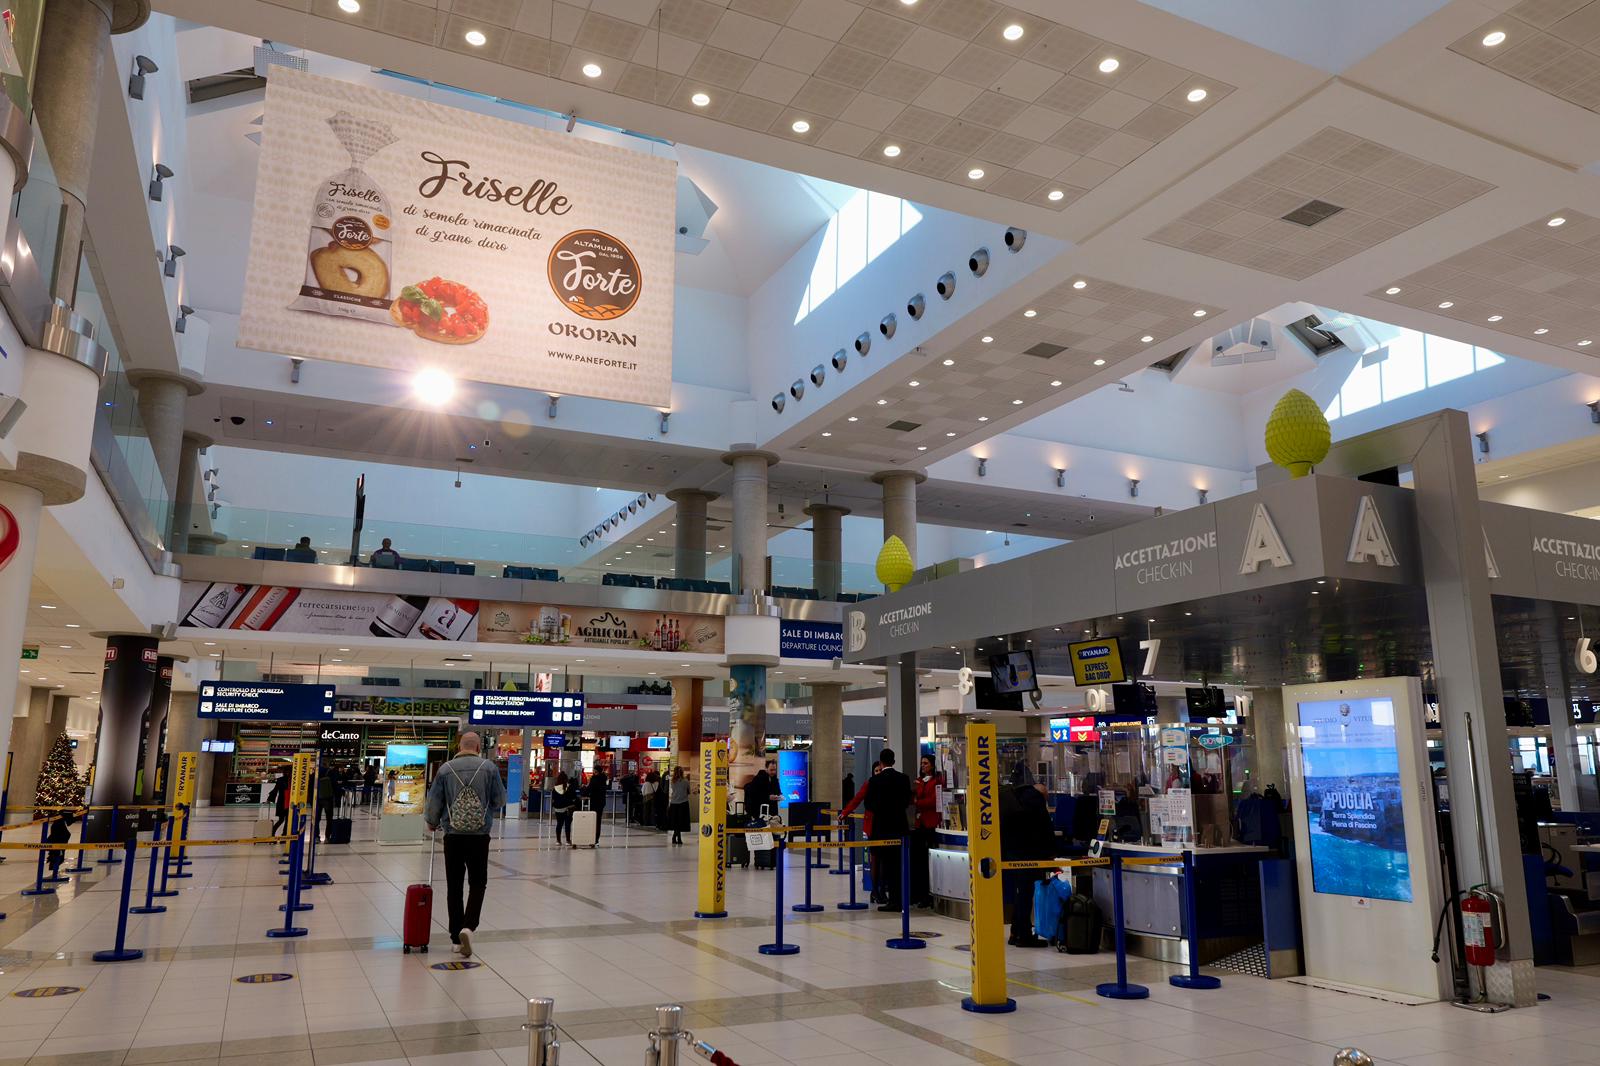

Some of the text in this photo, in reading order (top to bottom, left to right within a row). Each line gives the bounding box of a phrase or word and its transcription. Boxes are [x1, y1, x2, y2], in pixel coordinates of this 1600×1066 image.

[328, 181, 382, 202] Friselle
[418, 151, 572, 216] Friselle
[336, 223, 370, 242] Forte
[403, 204, 542, 240] di semola rimacinata
[416, 225, 508, 251] di grano duro
[574, 240, 618, 253] ALTAMURA
[556, 250, 636, 296] Forte
[548, 322, 637, 348] OROPAN
[548, 350, 638, 370] WWW.PANEFORTE.IT
[1238, 502, 1293, 575] A
[1346, 494, 1400, 567] A
[1114, 531, 1217, 570] ACCETTAZIONE
[1136, 560, 1193, 584] CHECK-IN
[878, 602, 932, 626] ACCETTAZIONE
[575, 626, 638, 640] AGRICOLA
[782, 628, 801, 638] SALE
[804, 630, 812, 638] DI
[848, 610, 867, 652] B
[890, 621, 920, 638] CHECK-IN
[782, 642, 843, 652] DEPARTURE LOUNG
[1082, 648, 1109, 657] RYANAIR
[1139, 638, 1161, 676] 7
[1574, 638, 1598, 674] 6
[1084, 662, 1108, 672] EXPRESS
[1084, 670, 1112, 680] BAG DROP
[958, 666, 973, 696] 8
[321, 730, 360, 740] deCanto
[566, 736, 580, 746] 22
[178, 756, 188, 791] RYANAIR
[704, 749, 712, 804] RYANAIR
[978, 736, 992, 826] RYANAIR
[1331, 792, 1374, 810] PUGLIA
[1348, 812, 1376, 820] Splendida
